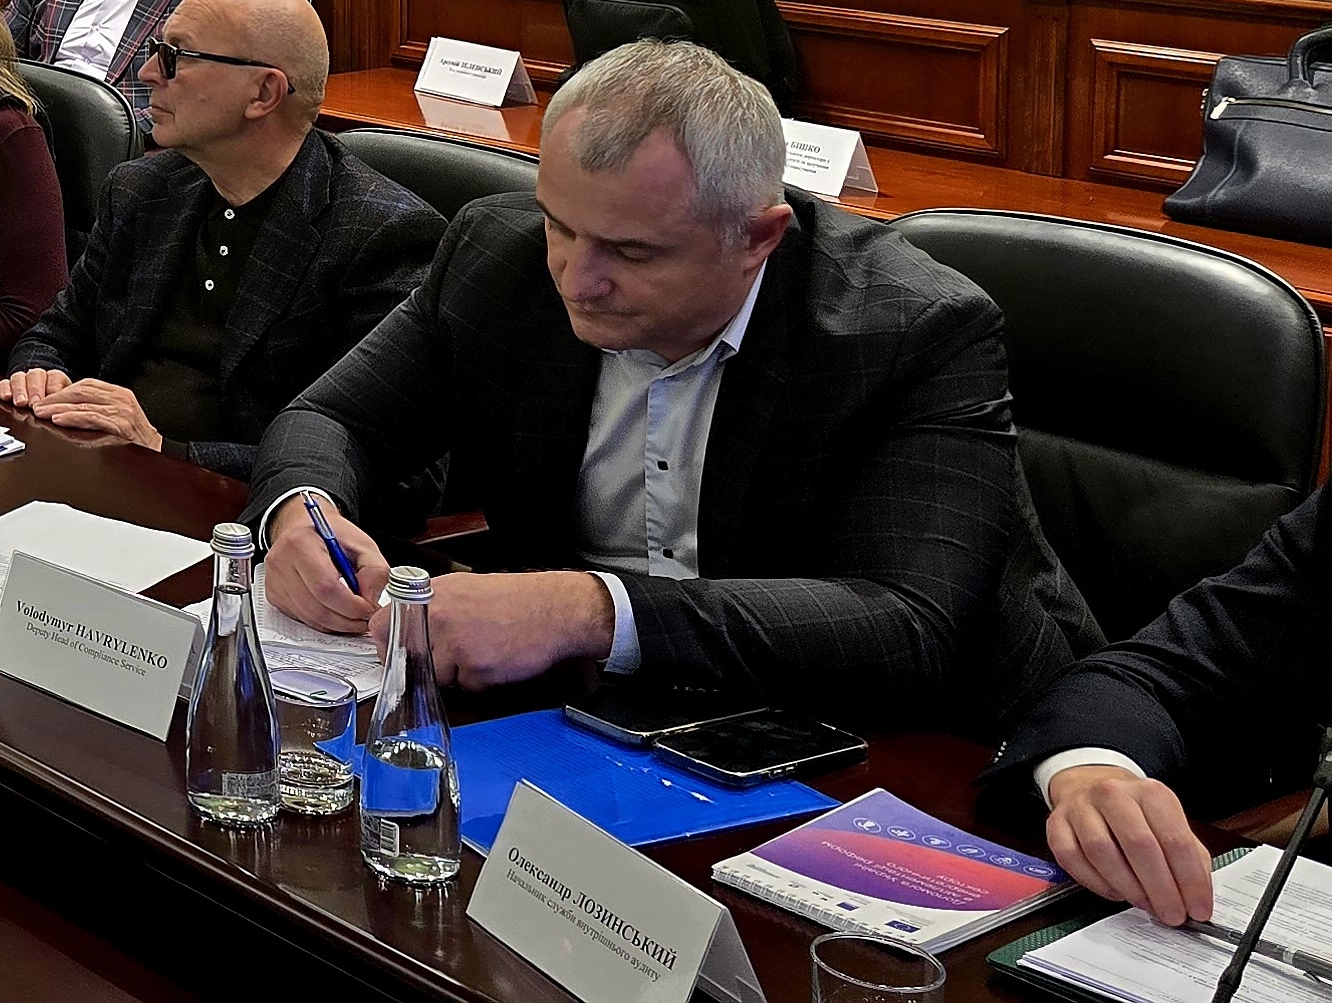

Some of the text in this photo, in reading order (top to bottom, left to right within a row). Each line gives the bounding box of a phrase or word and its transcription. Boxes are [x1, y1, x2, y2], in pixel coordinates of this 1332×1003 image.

[16, 600, 168, 669] Volodymyr HAVRYLENKO
[26, 621, 147, 677] Deputy Head of Compliance Service
[506, 868, 661, 983] Начальник служби внутрішнього аудиту
[508, 847, 678, 971] Олександр ЛОЗИНСЬКИЙ
